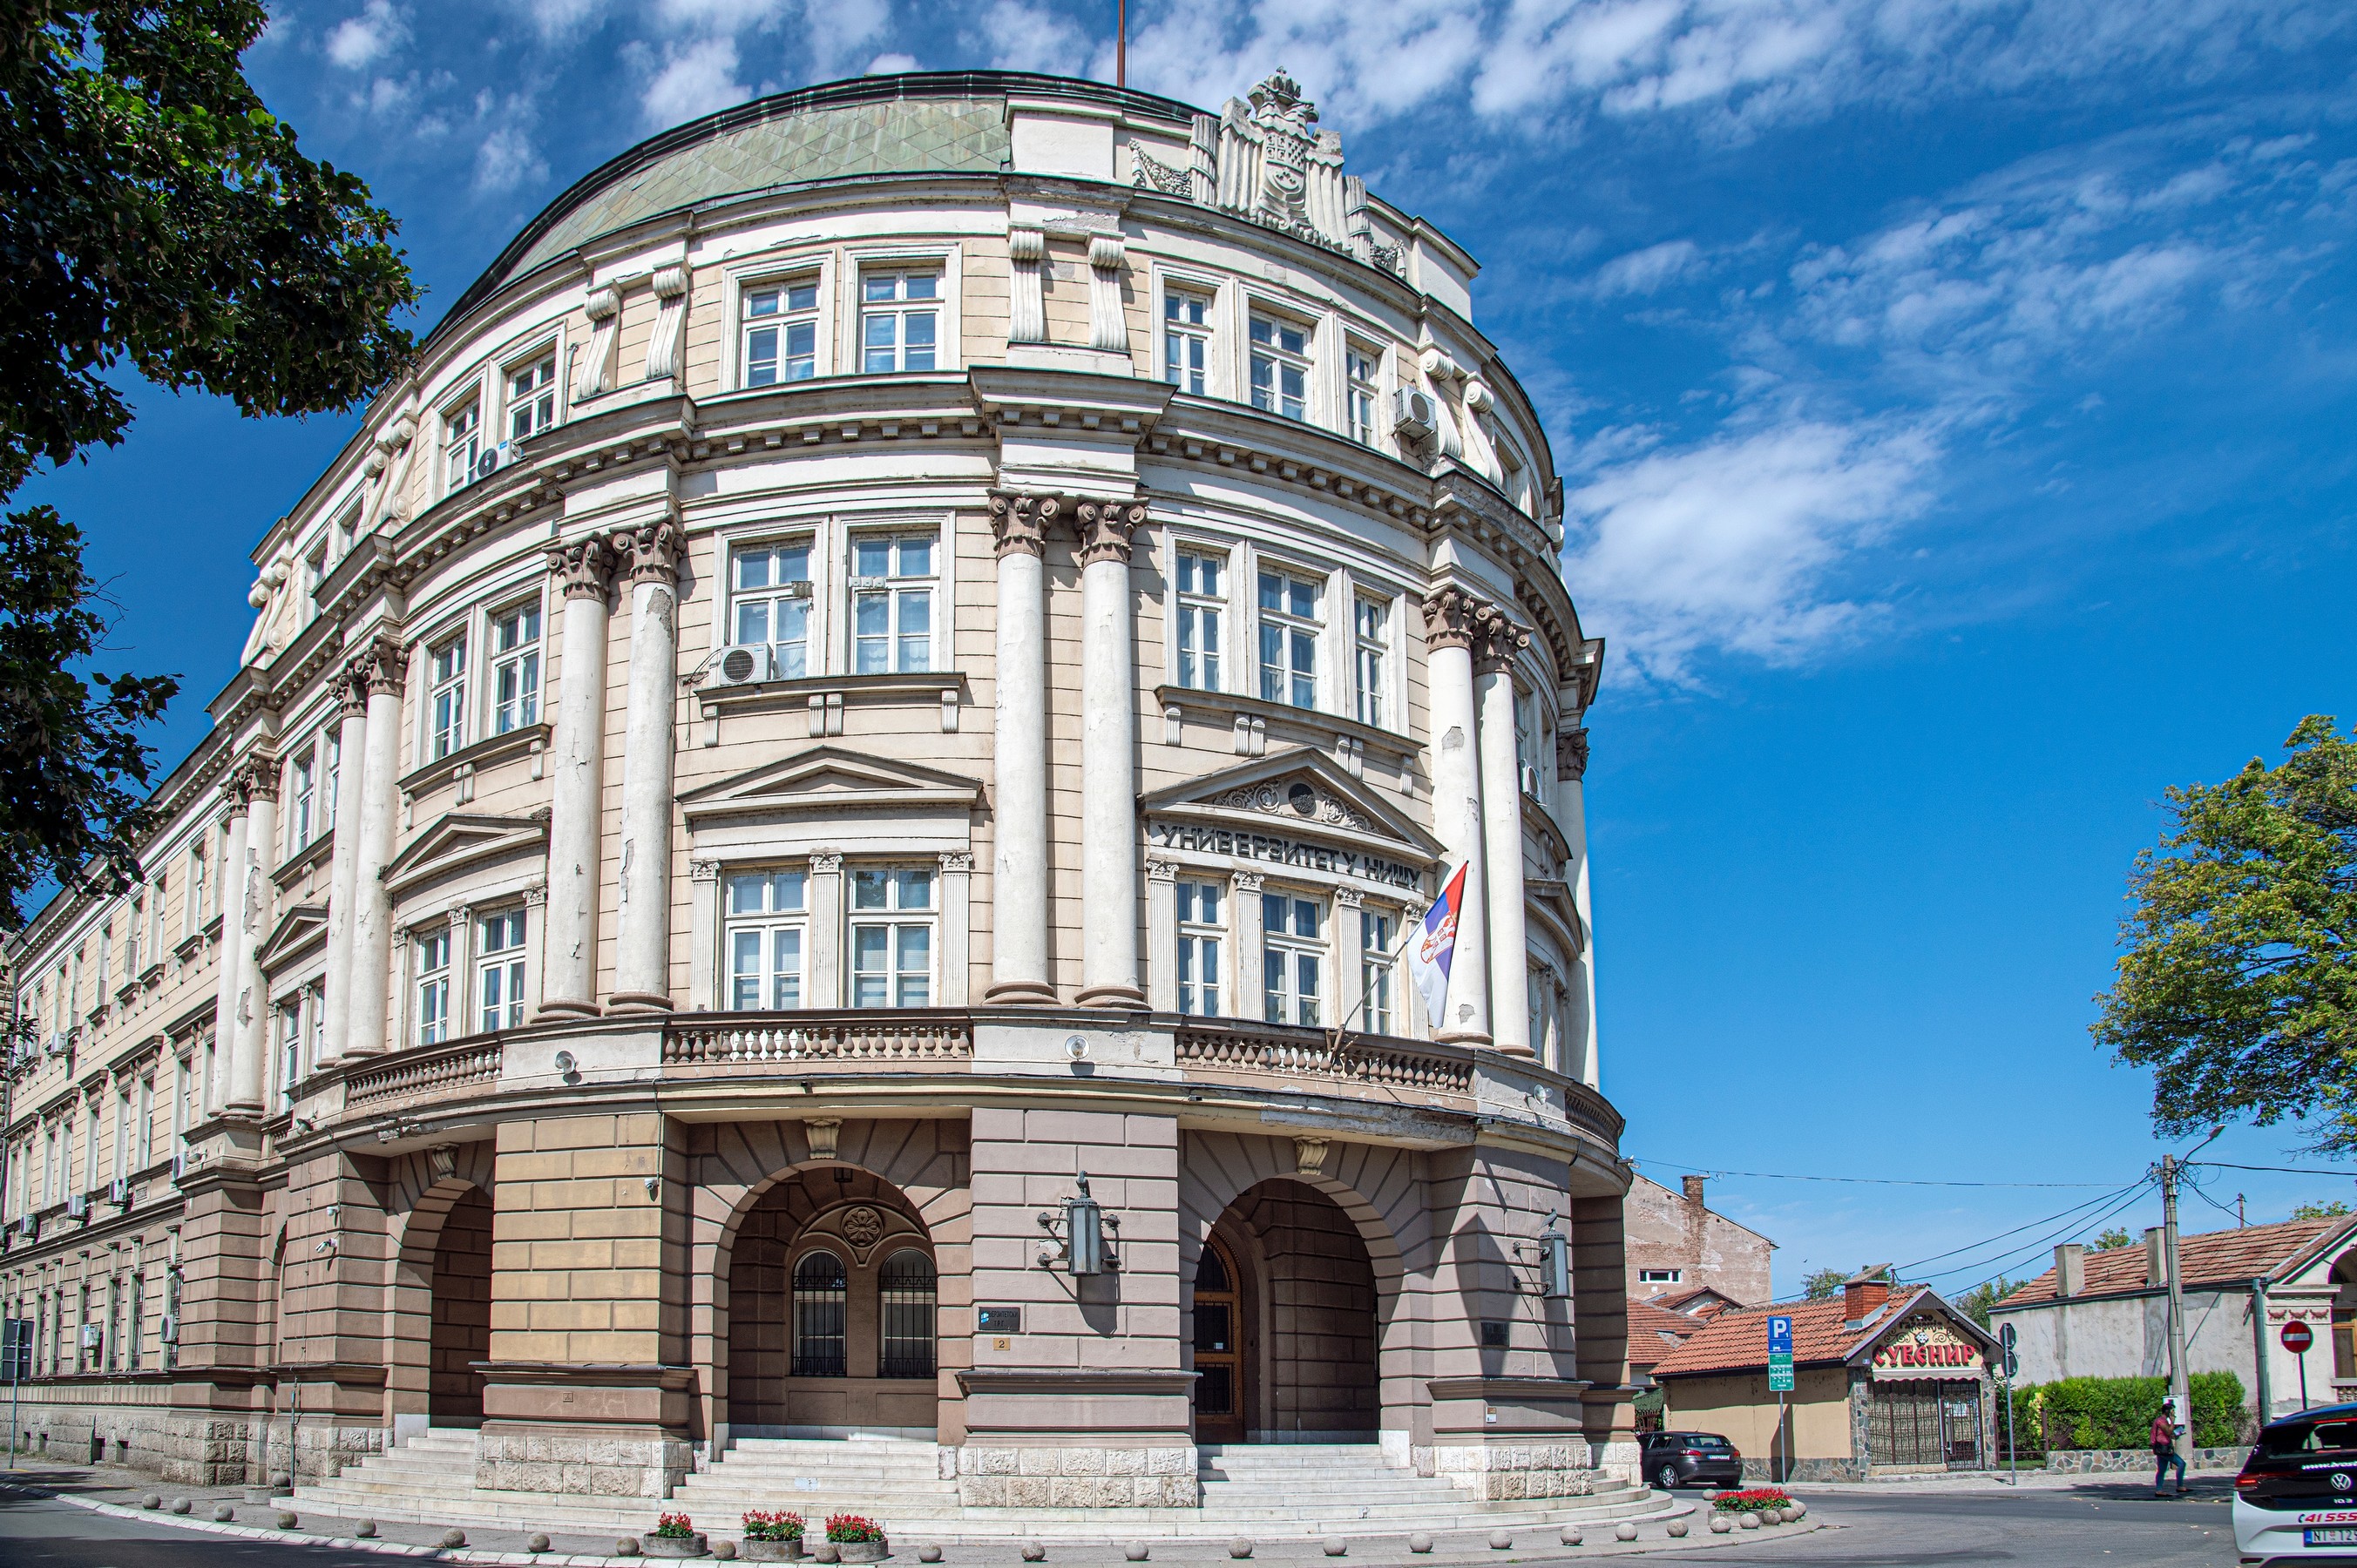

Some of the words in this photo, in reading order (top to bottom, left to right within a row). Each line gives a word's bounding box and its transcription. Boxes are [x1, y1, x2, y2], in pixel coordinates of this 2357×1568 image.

[1158, 824, 1339, 872] УНИВЕРЗИТЕТ
[1341, 851, 1358, 875] У
[1364, 856, 1421, 890] НИШУ
[1773, 1319, 1787, 1338] P
[999, 1340, 1005, 1348] 2
[1873, 1344, 1975, 1368] СУВЕНИР
[2305, 1513, 2322, 1523] 41
[2313, 1531, 2326, 1542] NI
